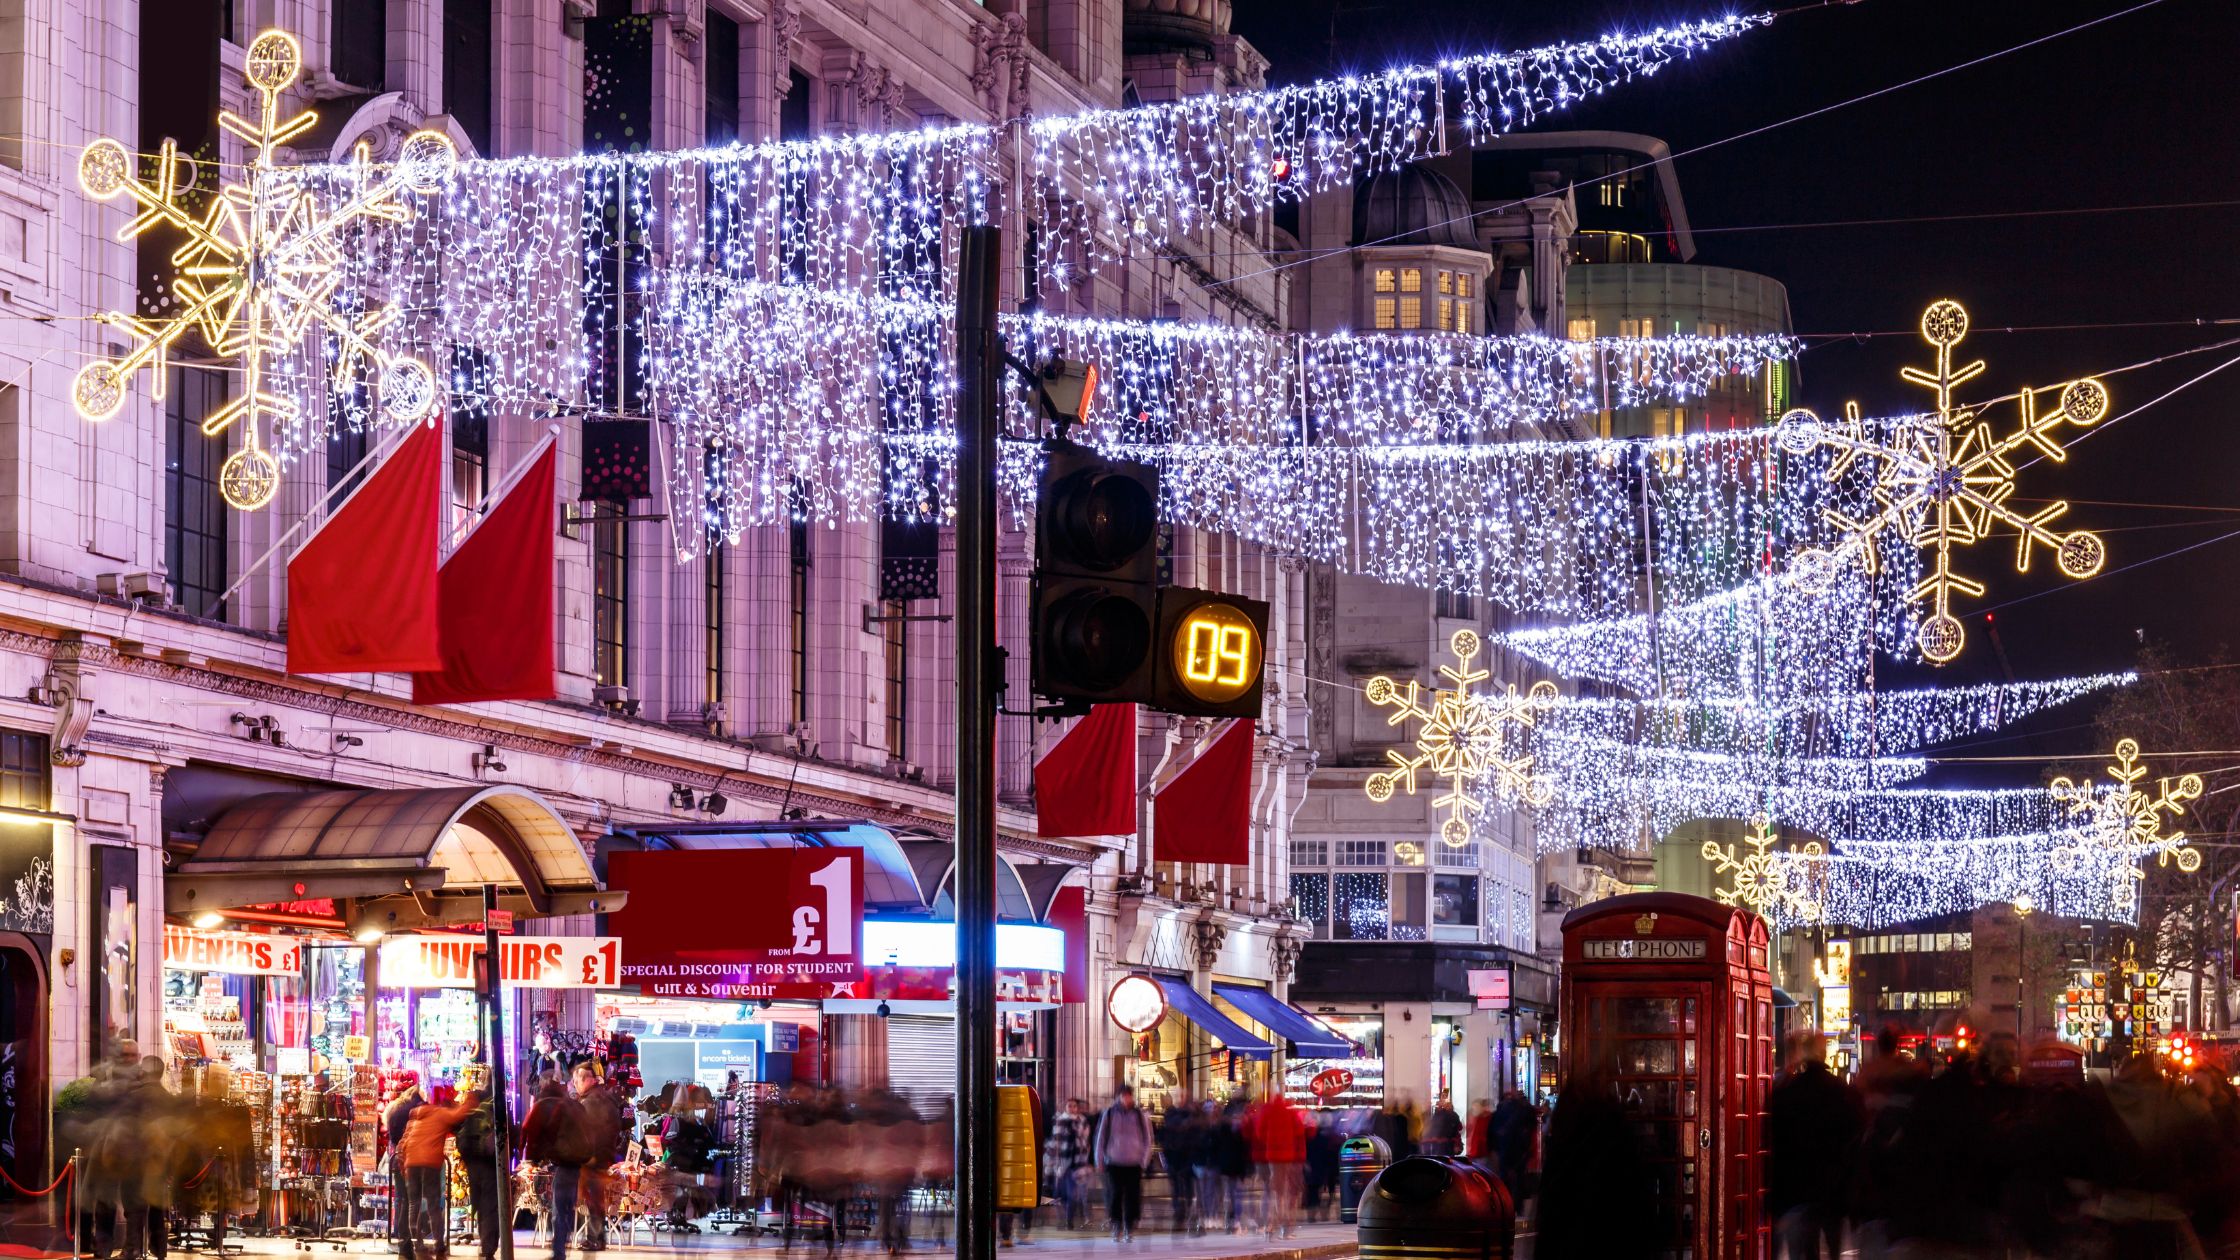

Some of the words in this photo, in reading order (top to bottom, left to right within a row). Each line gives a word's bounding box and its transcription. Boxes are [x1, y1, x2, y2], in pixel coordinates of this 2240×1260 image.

[1186, 621, 1250, 686] 09
[768, 948, 791, 956] FROM
[792, 856, 852, 955] £1
[282, 945, 301, 972] £1
[1589, 941, 1702, 958] TELPHONE
[582, 941, 617, 985] £1
[620, 965, 676, 976] SPECIAL
[682, 964, 751, 976] DISCOUNT
[755, 963, 784, 974] FOR
[786, 962, 854, 974] STUDENT
[653, 983, 681, 994] Gift
[684, 983, 698, 995] &
[701, 983, 777, 996] Souvenir
[702, 1055, 727, 1063] encore
[728, 1053, 751, 1063] tickets
[1312, 1072, 1351, 1094] SALE
